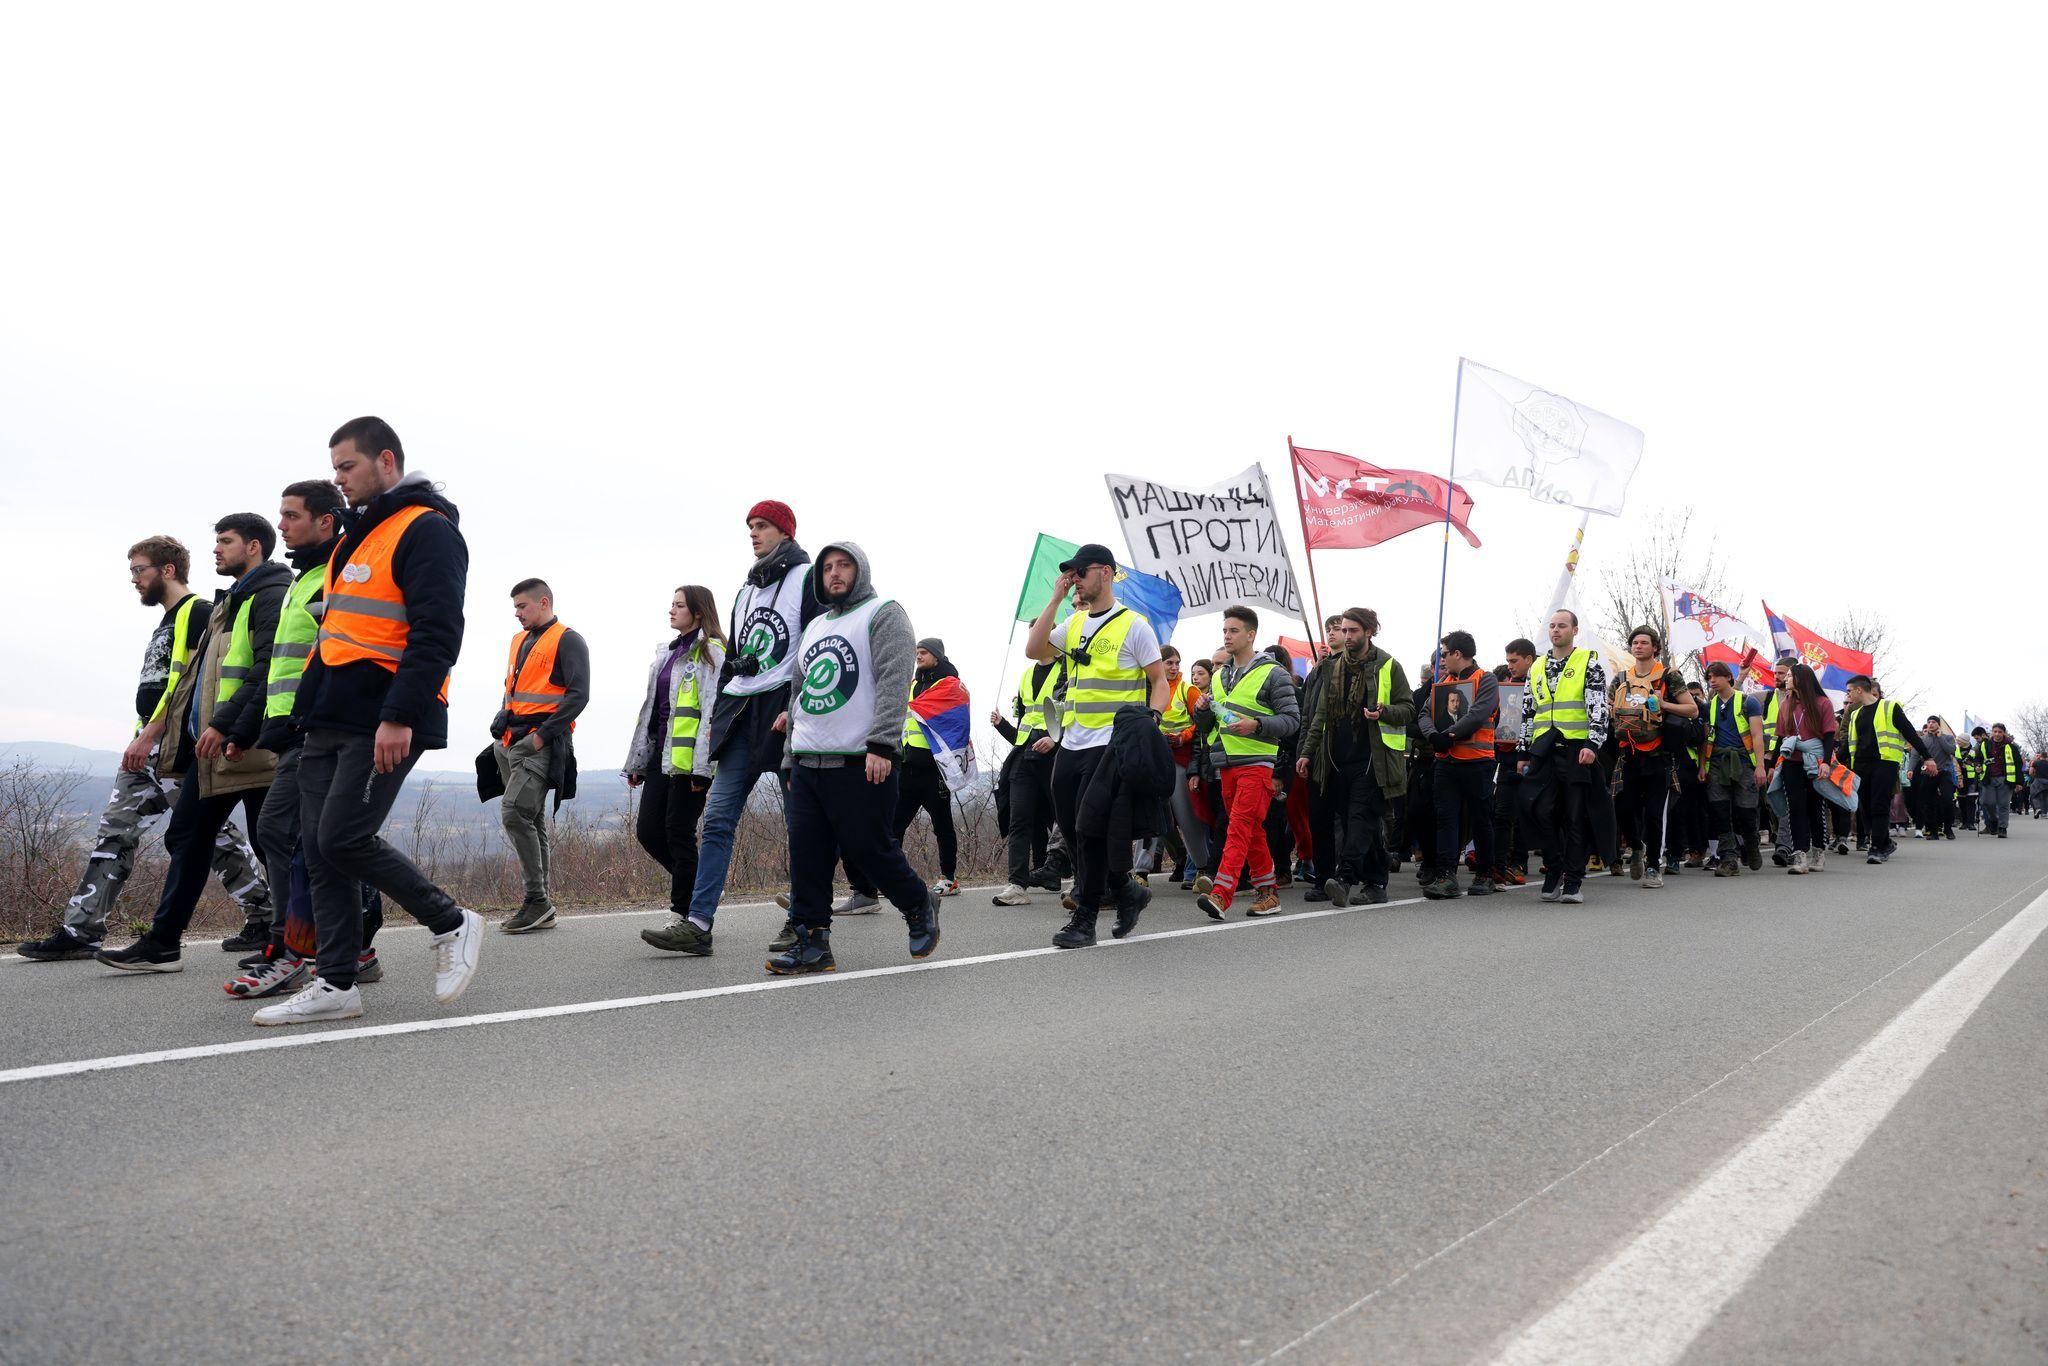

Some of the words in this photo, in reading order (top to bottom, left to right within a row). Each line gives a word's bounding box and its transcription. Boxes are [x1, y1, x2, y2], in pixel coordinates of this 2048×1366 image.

[1305, 505, 1382, 528] Математички
[1146, 518, 1286, 559] ПРОТИ
[1155, 561, 1300, 612] ШИНЕРИЈЕ
[747, 616, 754, 627] U
[808, 647, 818, 657] U
[818, 638, 856, 672] BLOKADE
[807, 694, 837, 711] FDU
